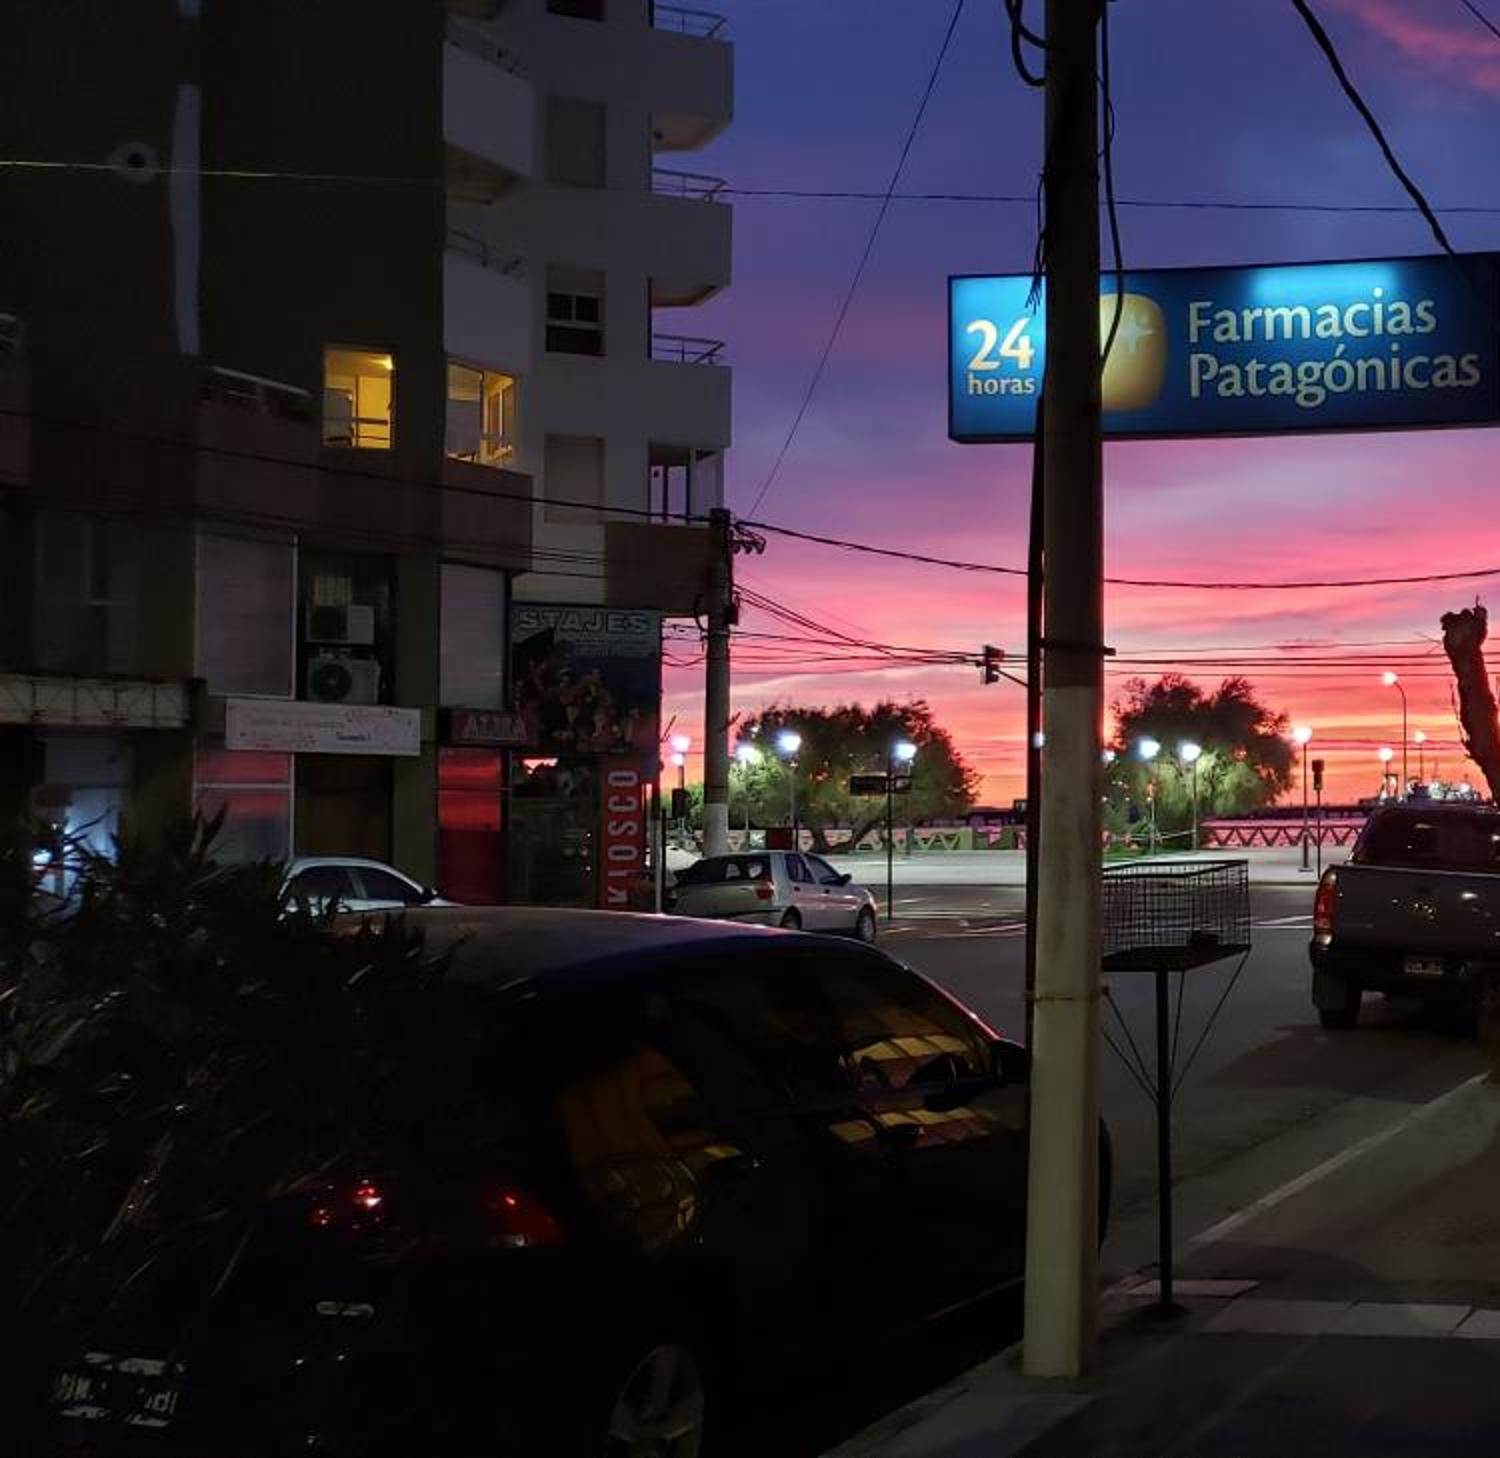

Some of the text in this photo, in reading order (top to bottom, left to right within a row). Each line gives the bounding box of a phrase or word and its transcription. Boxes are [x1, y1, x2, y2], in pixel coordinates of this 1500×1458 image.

[1189, 287, 1437, 343] Farmacias
[967, 318, 1035, 369] 24
[968, 372, 1035, 395] horas
[1189, 343, 1481, 408] Patagónicas
[607, 769, 639, 904] KIOSCO
